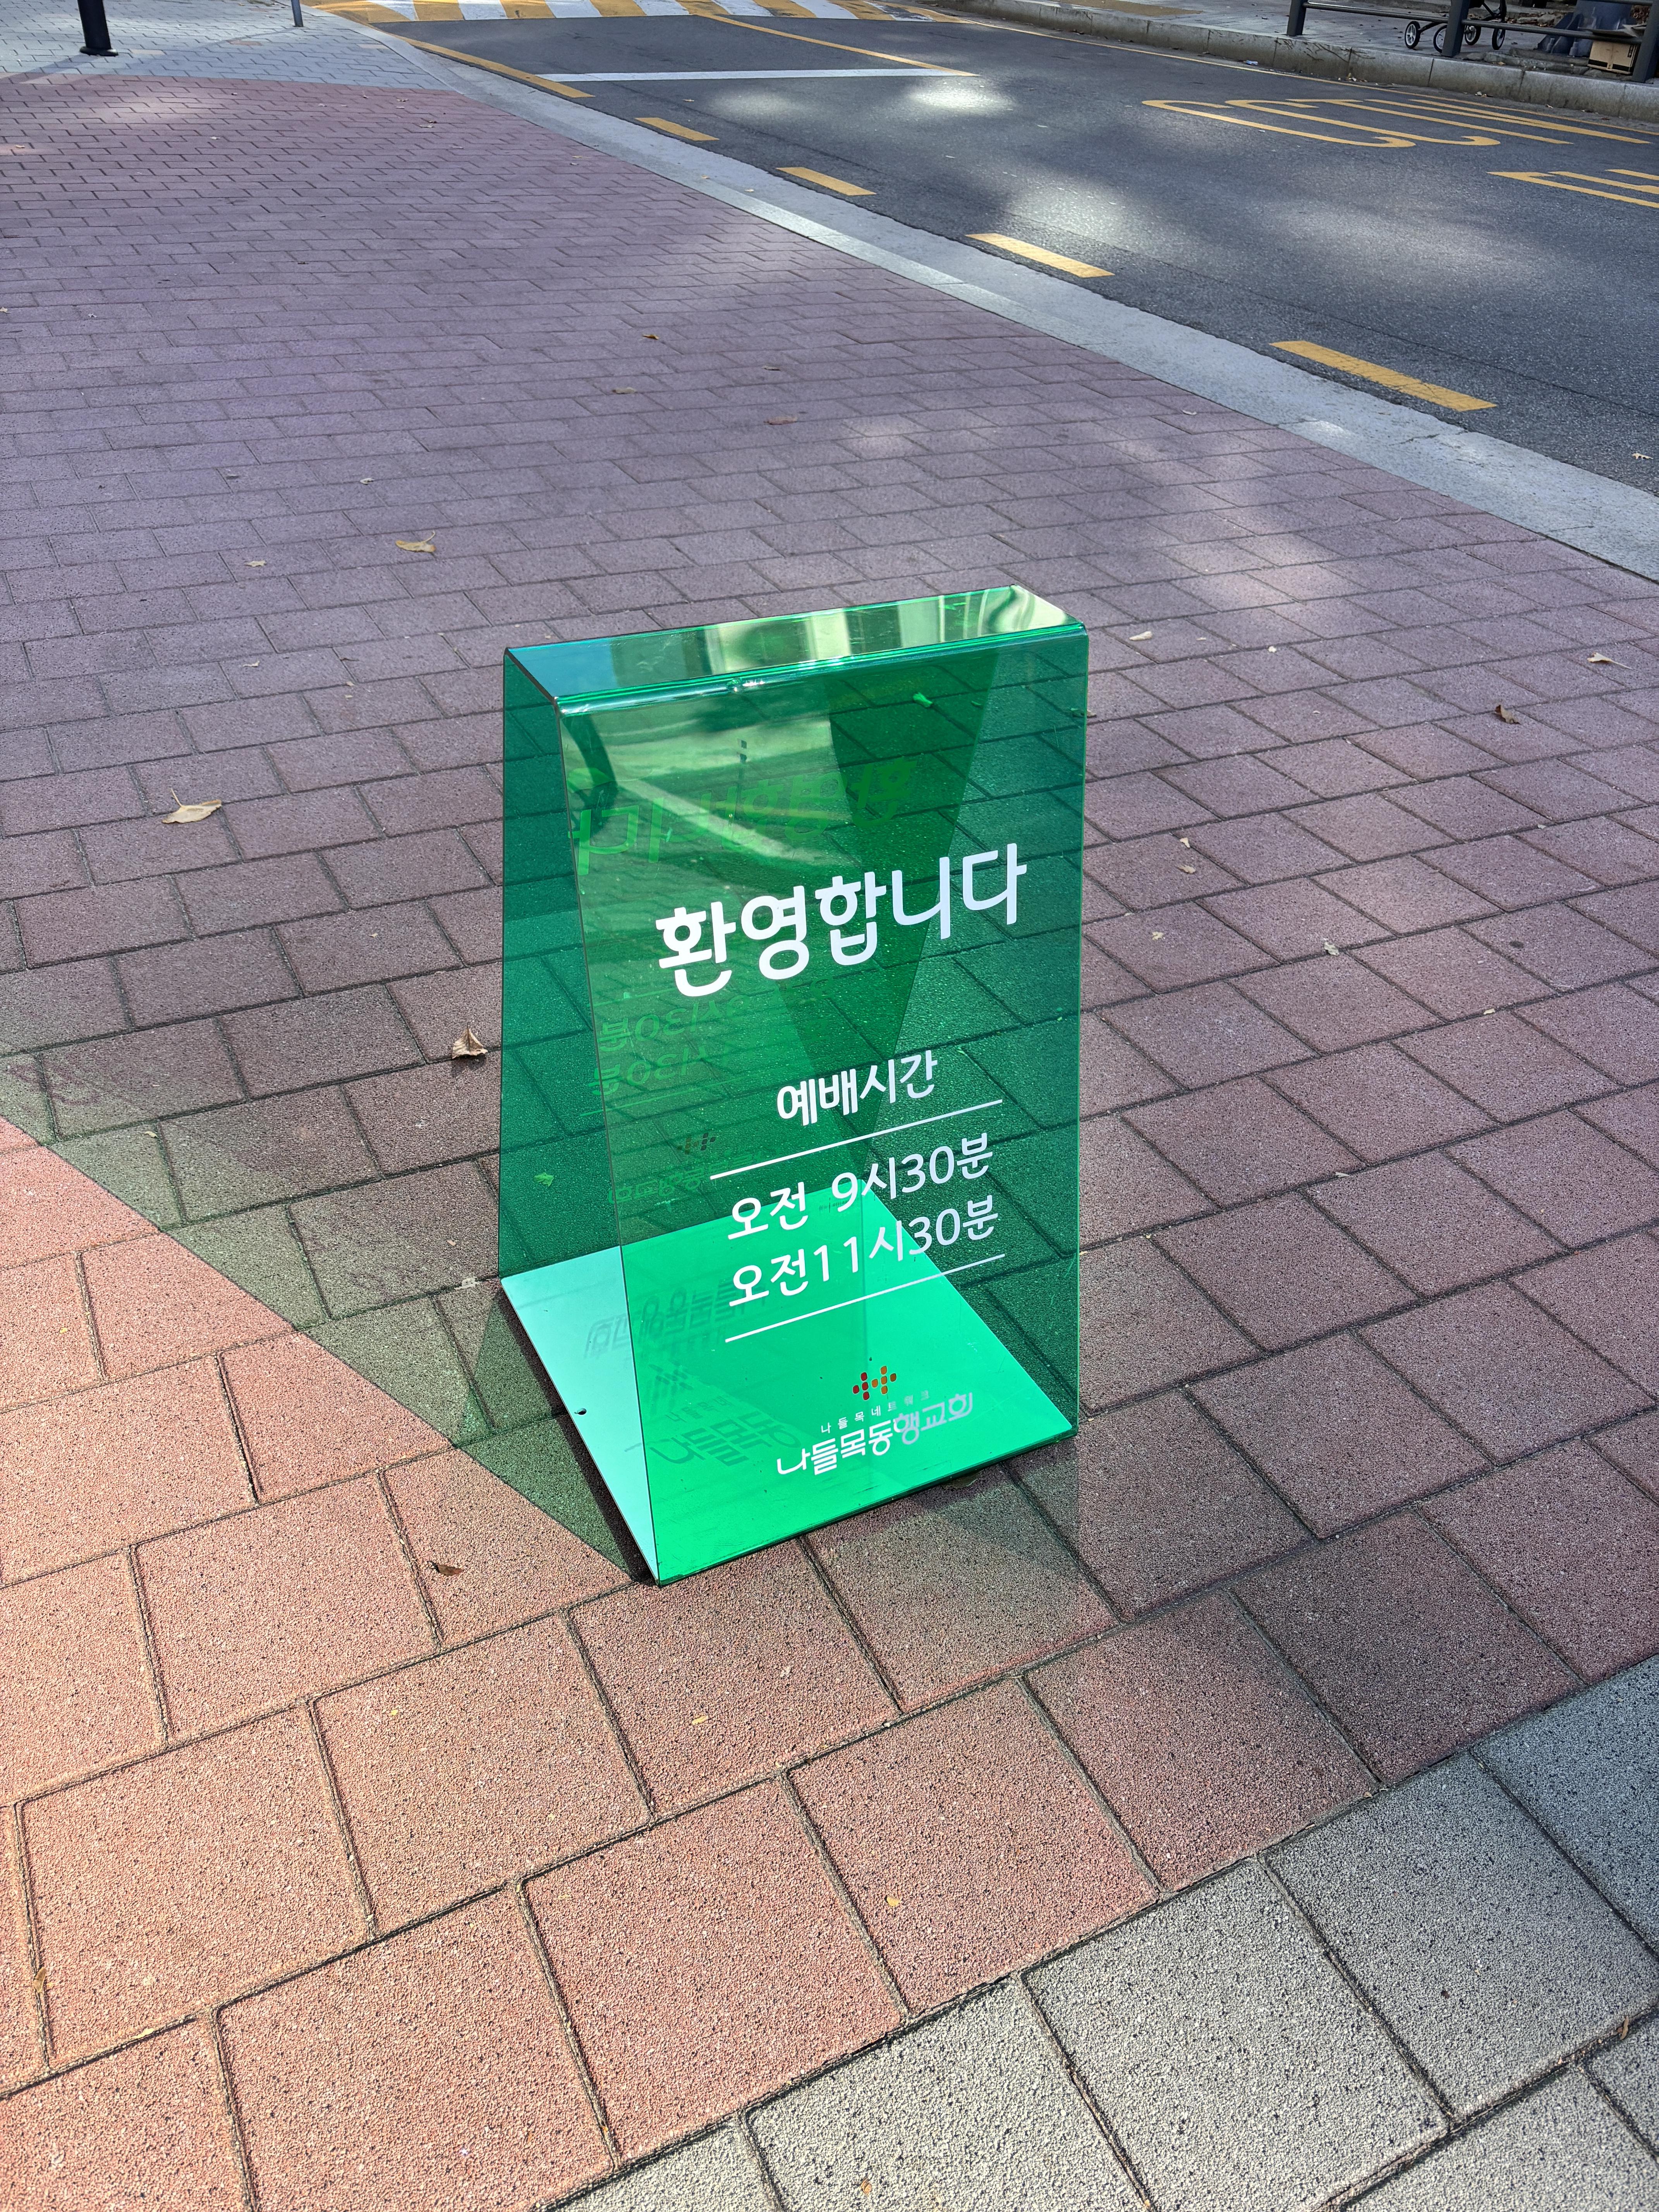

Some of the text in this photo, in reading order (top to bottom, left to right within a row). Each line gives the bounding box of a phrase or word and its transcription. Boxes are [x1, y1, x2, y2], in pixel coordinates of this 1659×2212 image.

[655, 842, 1027, 997] 환영합니다
[776, 1050, 938, 1126] 예배시간
[728, 1132, 993, 1240] 오전 9시30분
[776, 1392, 973, 1475] 나들목동행교회
